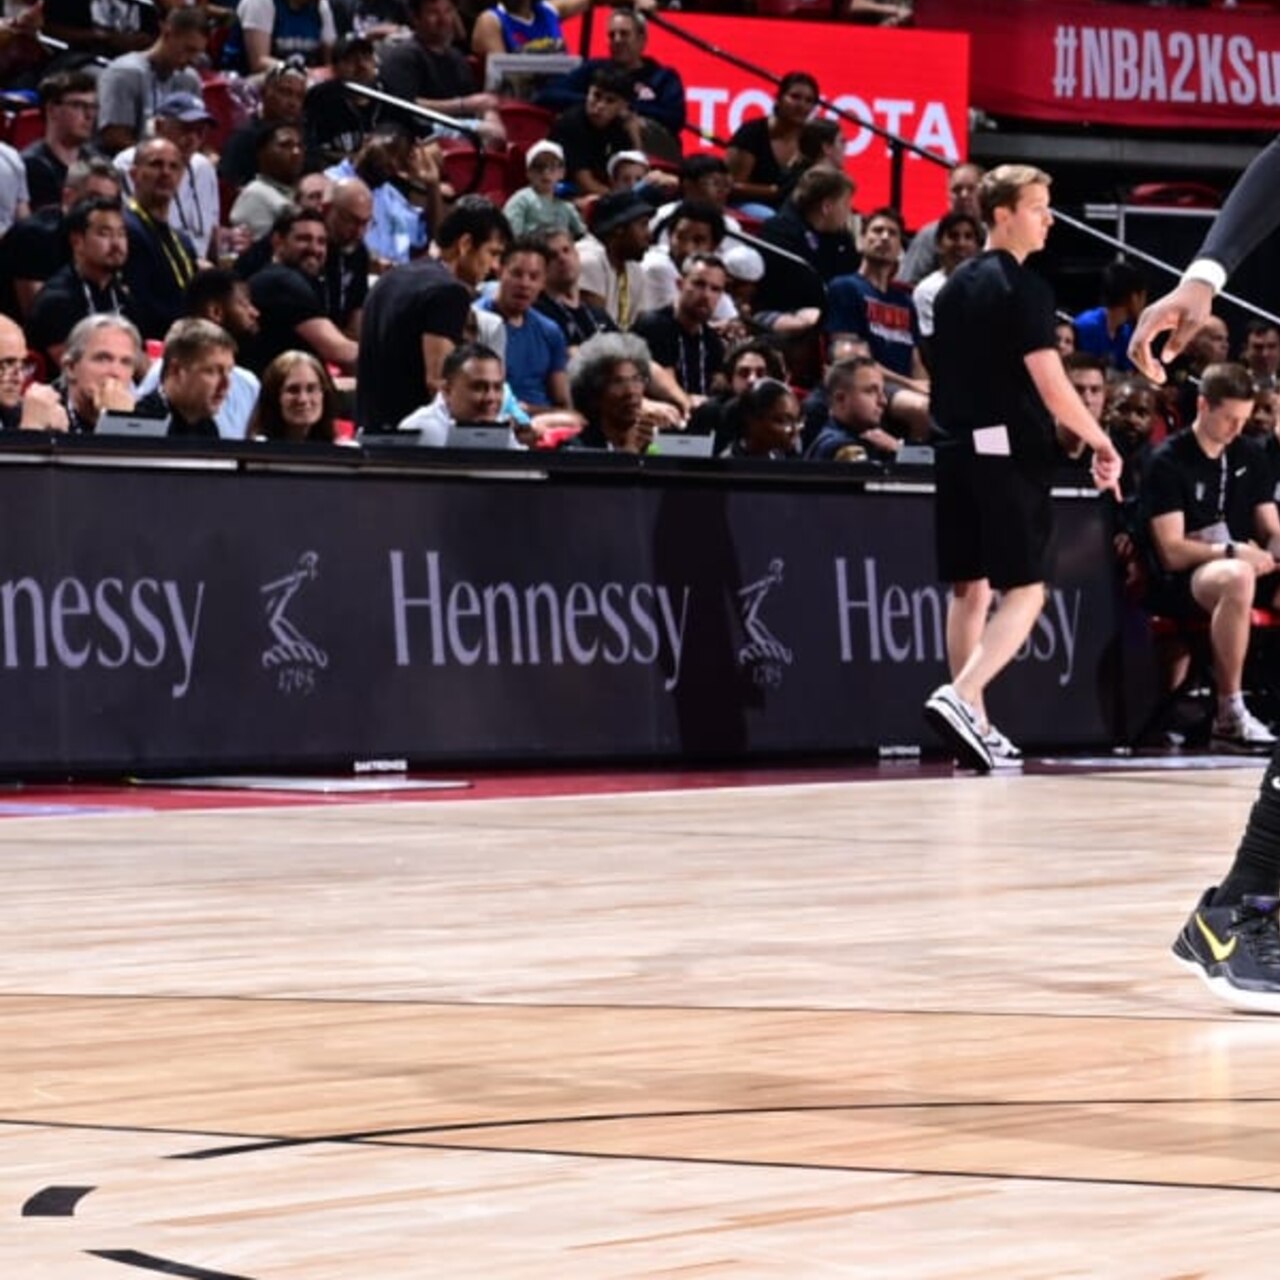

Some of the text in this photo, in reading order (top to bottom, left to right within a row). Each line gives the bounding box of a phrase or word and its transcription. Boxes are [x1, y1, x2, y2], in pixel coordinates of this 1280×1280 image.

[685, 86, 961, 161] TOOTA
[0, 576, 205, 699] nessy
[389, 550, 691, 692] Hennessy
[835, 556, 1081, 687] Hensy
